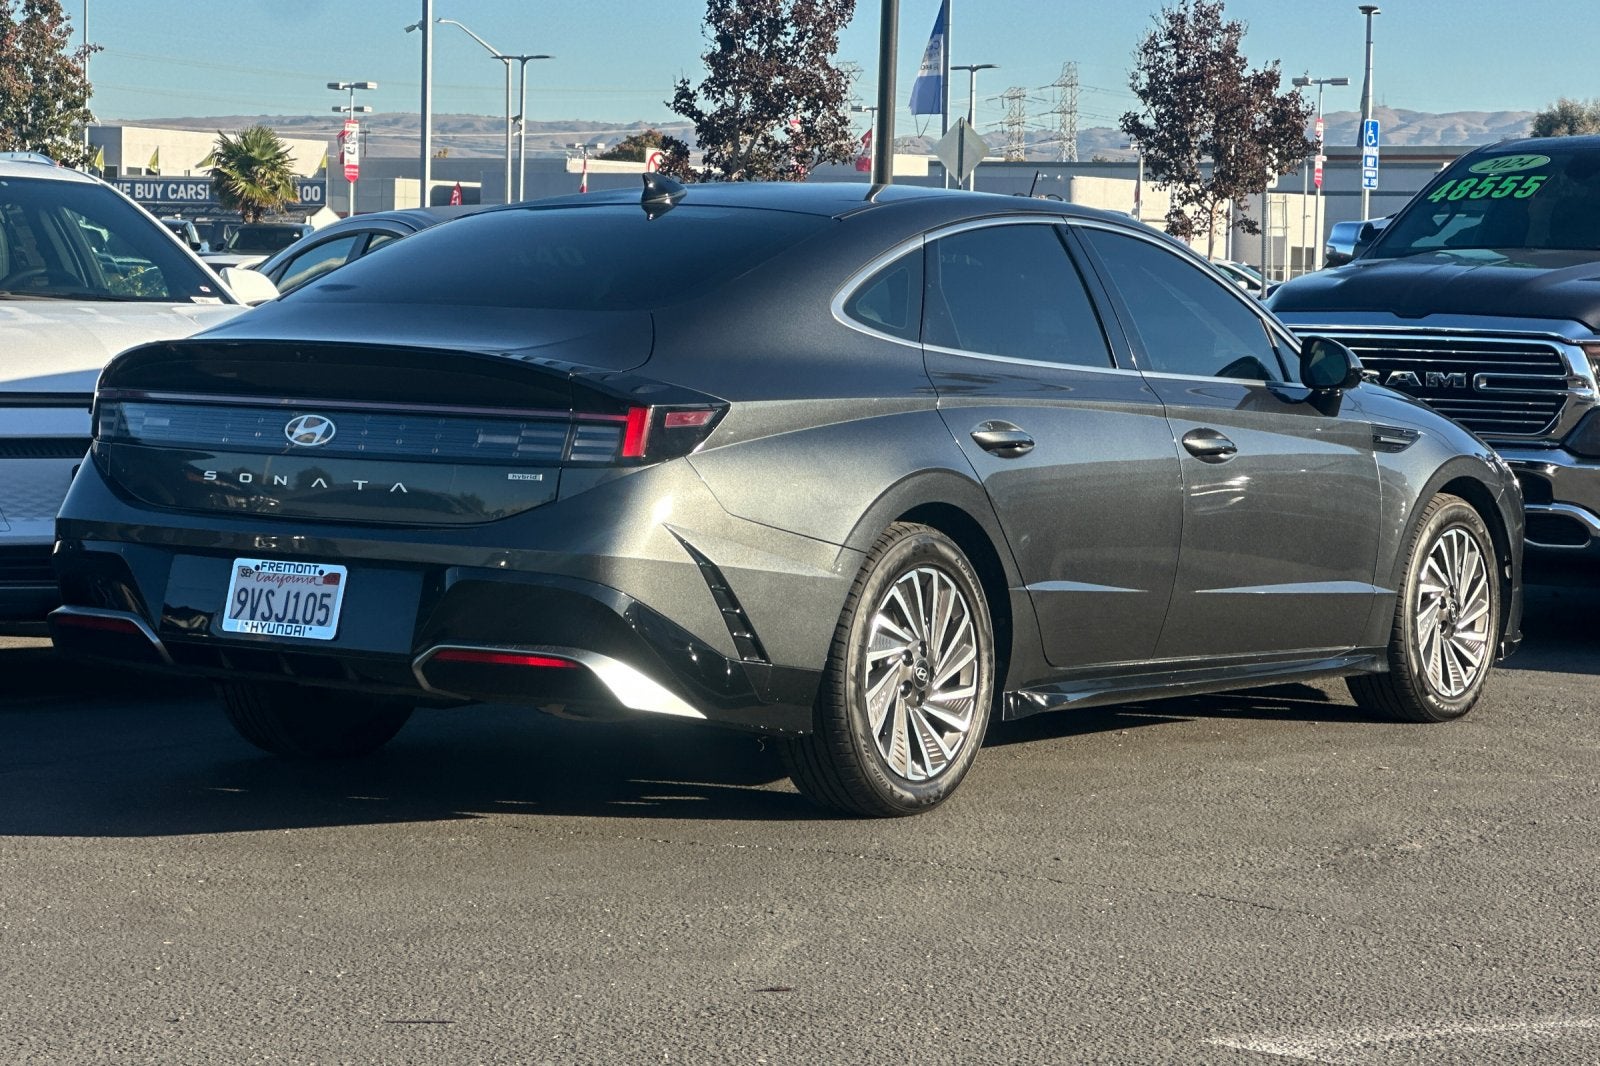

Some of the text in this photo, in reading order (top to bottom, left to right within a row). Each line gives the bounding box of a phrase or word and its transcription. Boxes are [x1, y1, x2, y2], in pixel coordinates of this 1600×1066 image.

[1480, 156, 1541, 171] 2024
[134, 183, 164, 199] BUY
[167, 184, 210, 200] CARS!
[1427, 175, 1548, 203] 48555
[203, 470, 408, 493] SONATA
[240, 567, 255, 578] SEP
[260, 561, 320, 575] FREMONT
[255, 572, 323, 589] California
[233, 587, 332, 627] 9VSJ105
[250, 621, 307, 637] HYUNDAI
